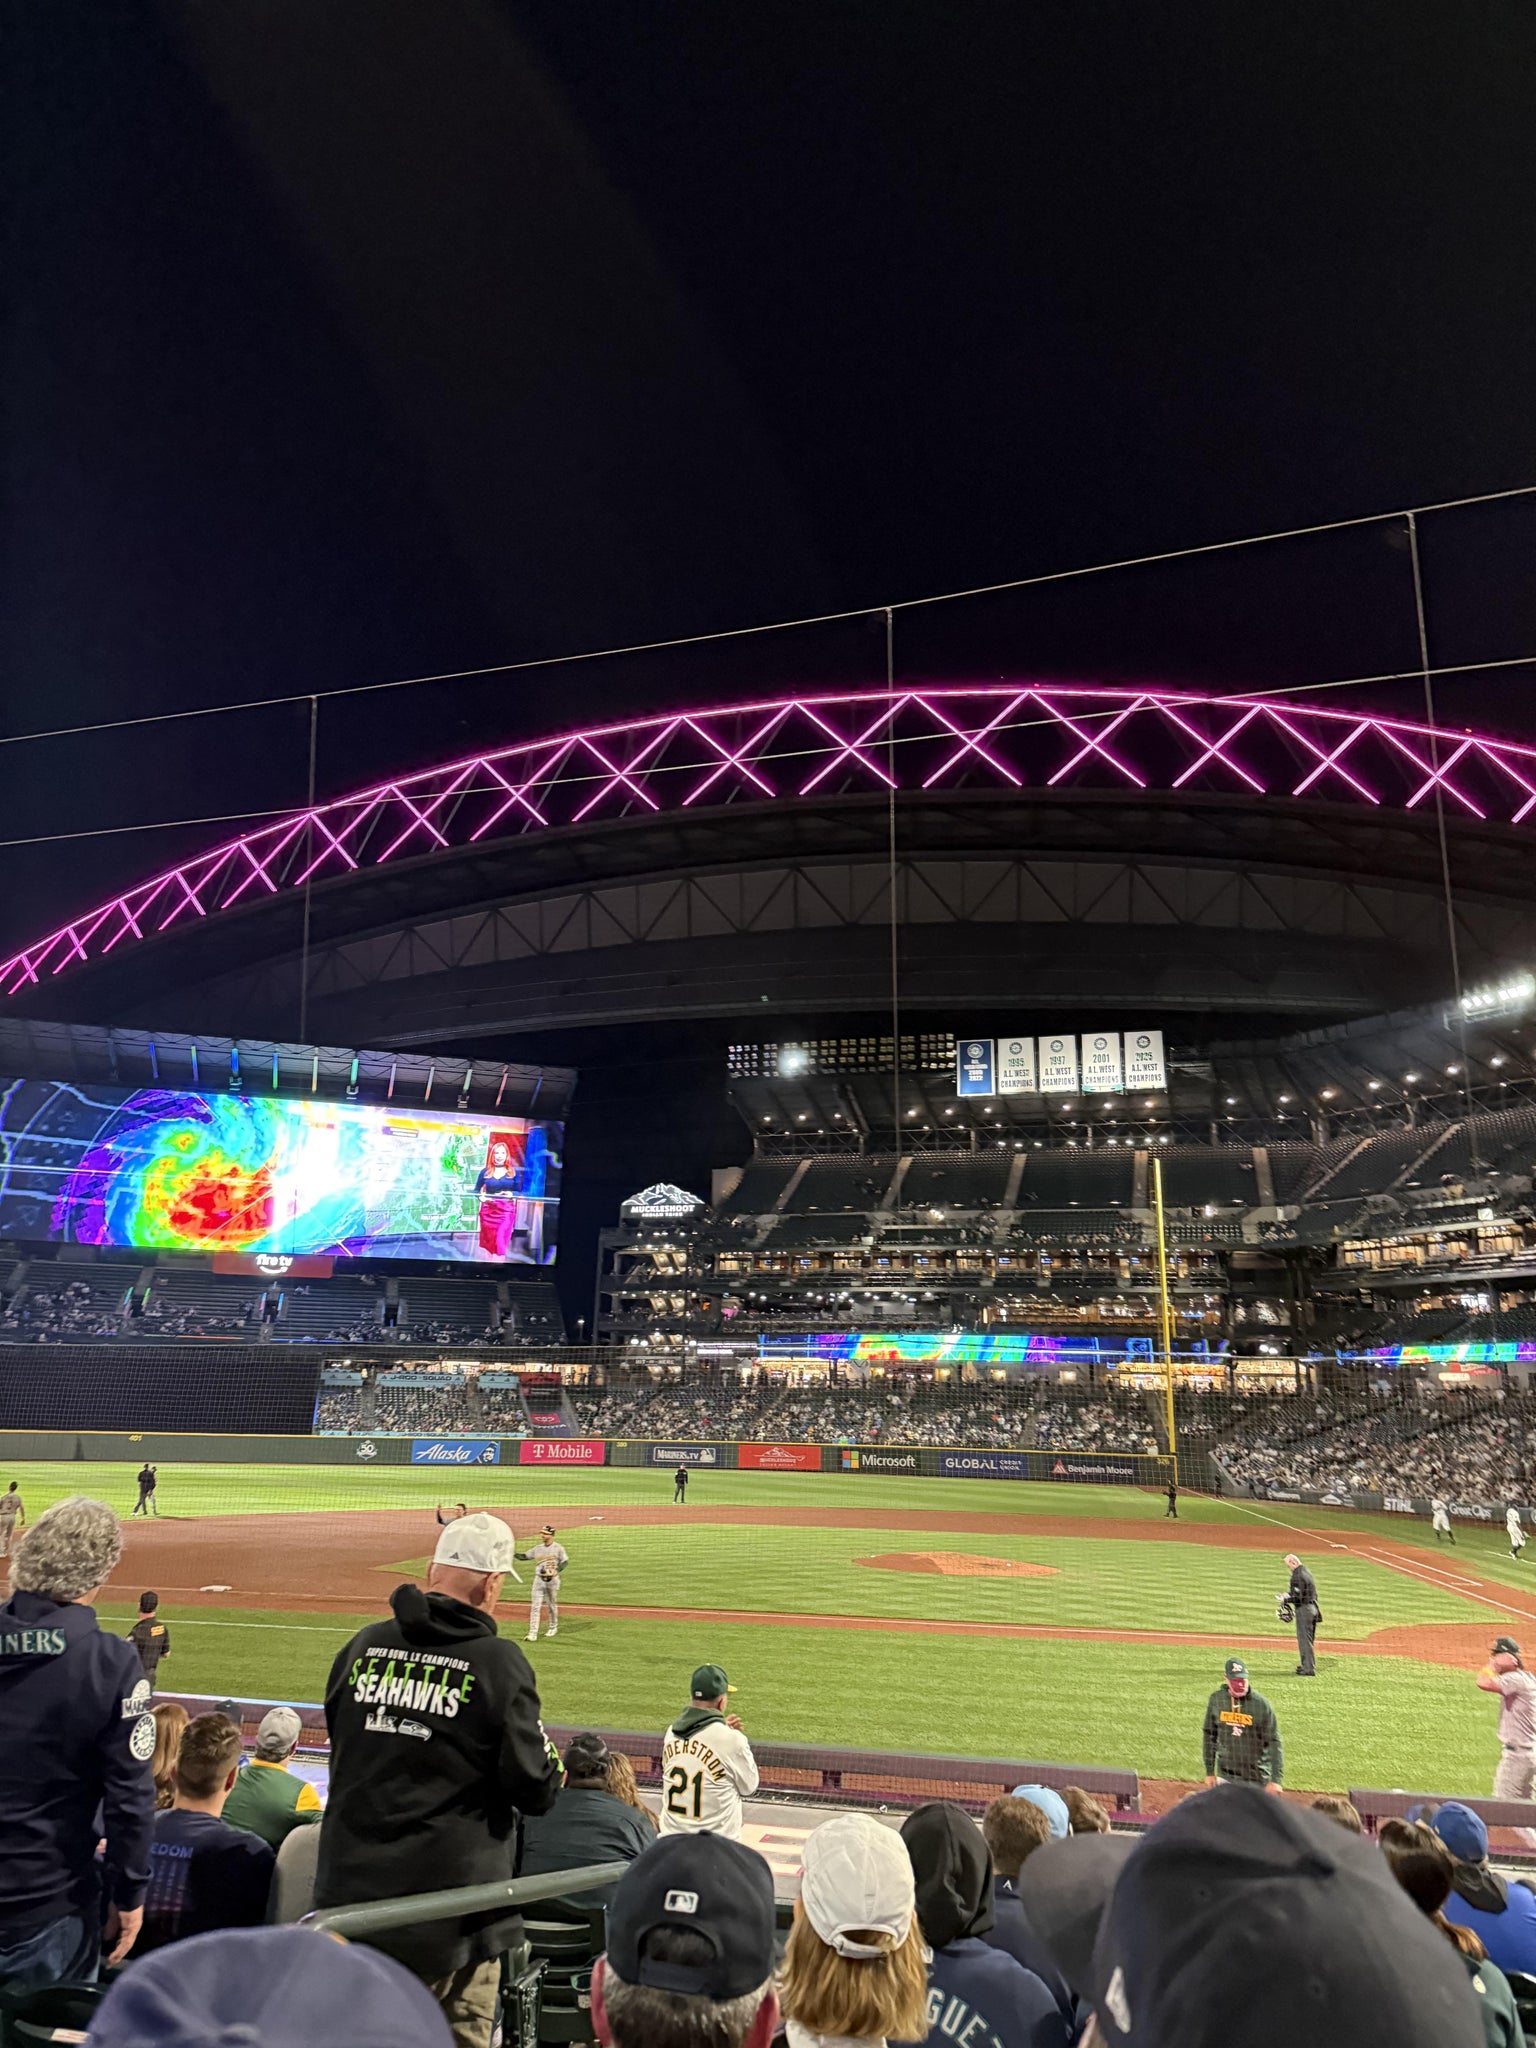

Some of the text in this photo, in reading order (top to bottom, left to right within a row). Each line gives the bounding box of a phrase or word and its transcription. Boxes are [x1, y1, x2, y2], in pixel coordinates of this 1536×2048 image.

[1093, 1054, 1110, 1063] 2001
[1014, 1069, 1030, 1077] WEST
[1056, 1067, 1071, 1075] WEST
[1100, 1065, 1115, 1073] WEST
[1143, 1063, 1158, 1071] WEST
[1000, 1079, 1033, 1088] CHAMPIONS
[1042, 1077, 1075, 1086] CHAMPIONS
[1085, 1076, 1119, 1084] CHAMPIONS
[1128, 1074, 1162, 1082] CHAMPIONS
[630, 1205, 695, 1213] MUCKLESHOOT
[256, 1254, 293, 1266] fire tv
[416, 1443, 473, 1462] Alaska
[547, 1443, 593, 1459] Mobile
[862, 1454, 916, 1468] Microsoft
[945, 1457, 998, 1470] GLOBAL
[1068, 1463, 1134, 1475] Benjamin Moore
[1384, 1498, 1416, 1513] STIHL
[365, 1647, 470, 1672] SUPER BOWL LX CHAMPIONS
[348, 1658, 476, 1704] SEATTLE
[354, 1673, 461, 1718] SEAHAWKS
[667, 1765, 704, 1819] 21
